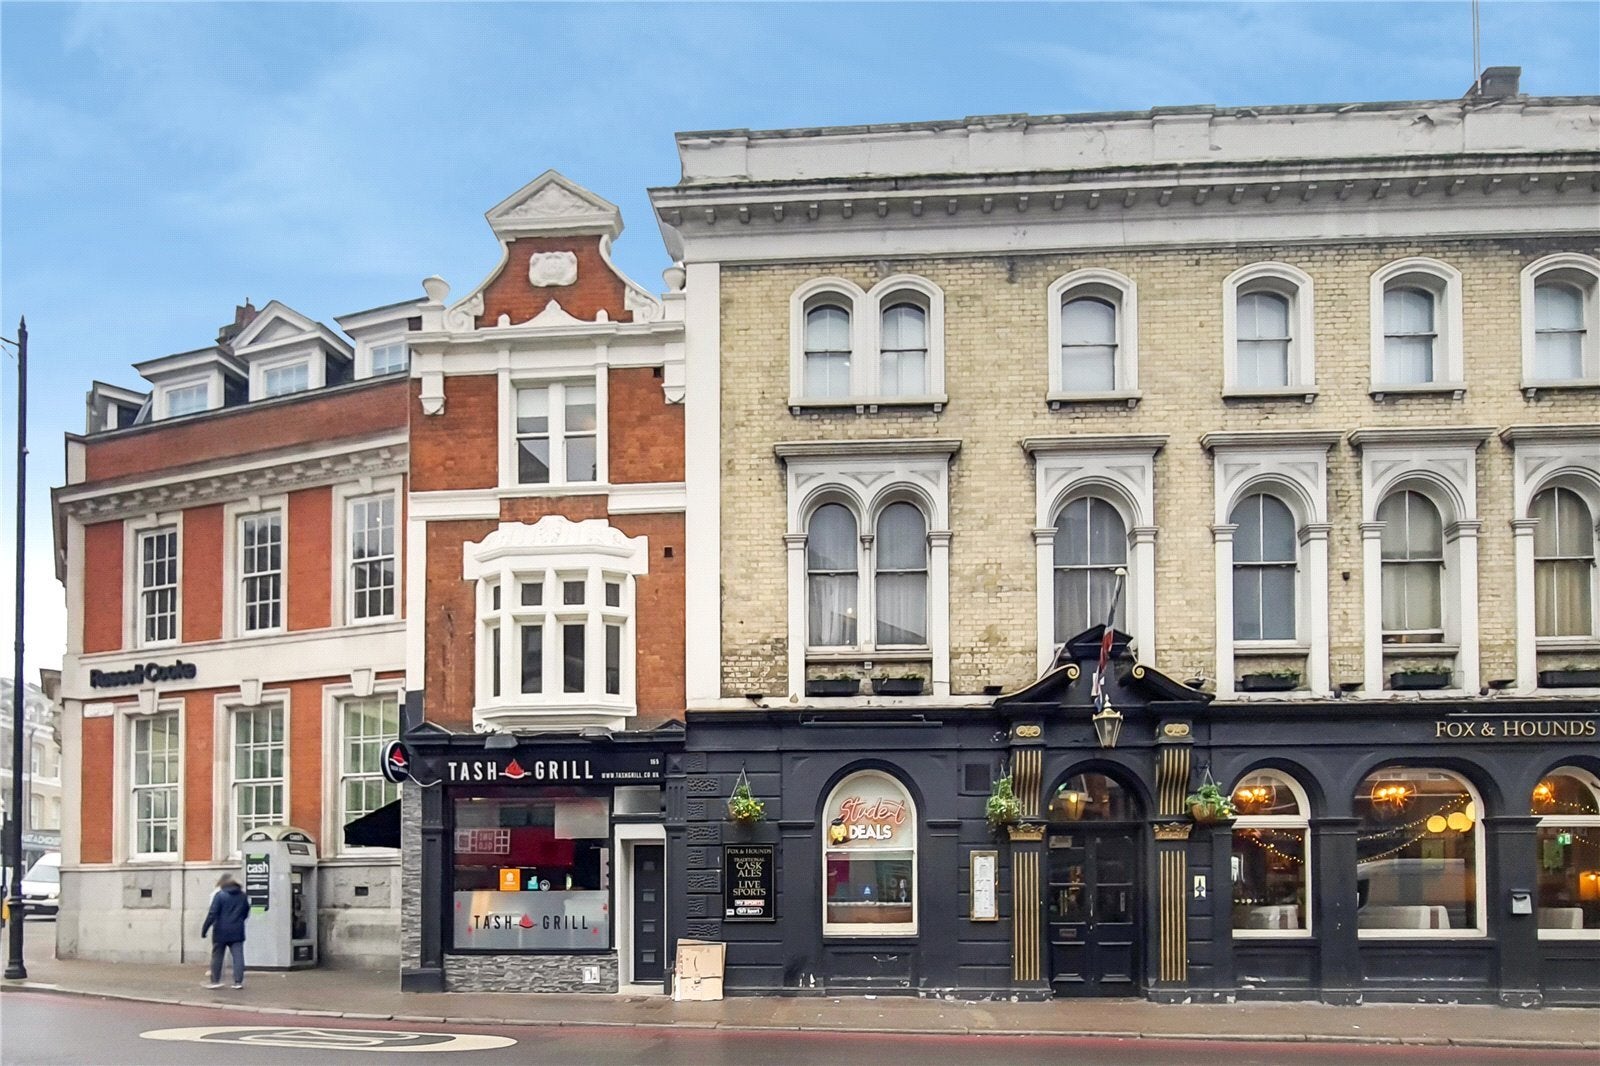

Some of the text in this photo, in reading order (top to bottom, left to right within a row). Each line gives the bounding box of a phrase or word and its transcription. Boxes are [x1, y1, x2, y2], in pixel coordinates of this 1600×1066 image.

[1435, 720, 1597, 738] FOX & HOUNDS
[448, 760, 594, 781] TASH GRILL
[839, 797, 906, 825] Student
[848, 824, 893, 840] DEALS
[247, 861, 269, 873] cash
[736, 861, 762, 870] CASK
[738, 869, 762, 878] ALES
[738, 880, 761, 889] LIVE
[732, 888, 767, 896] SPORTS
[474, 915, 588, 930] TASH GRILL
